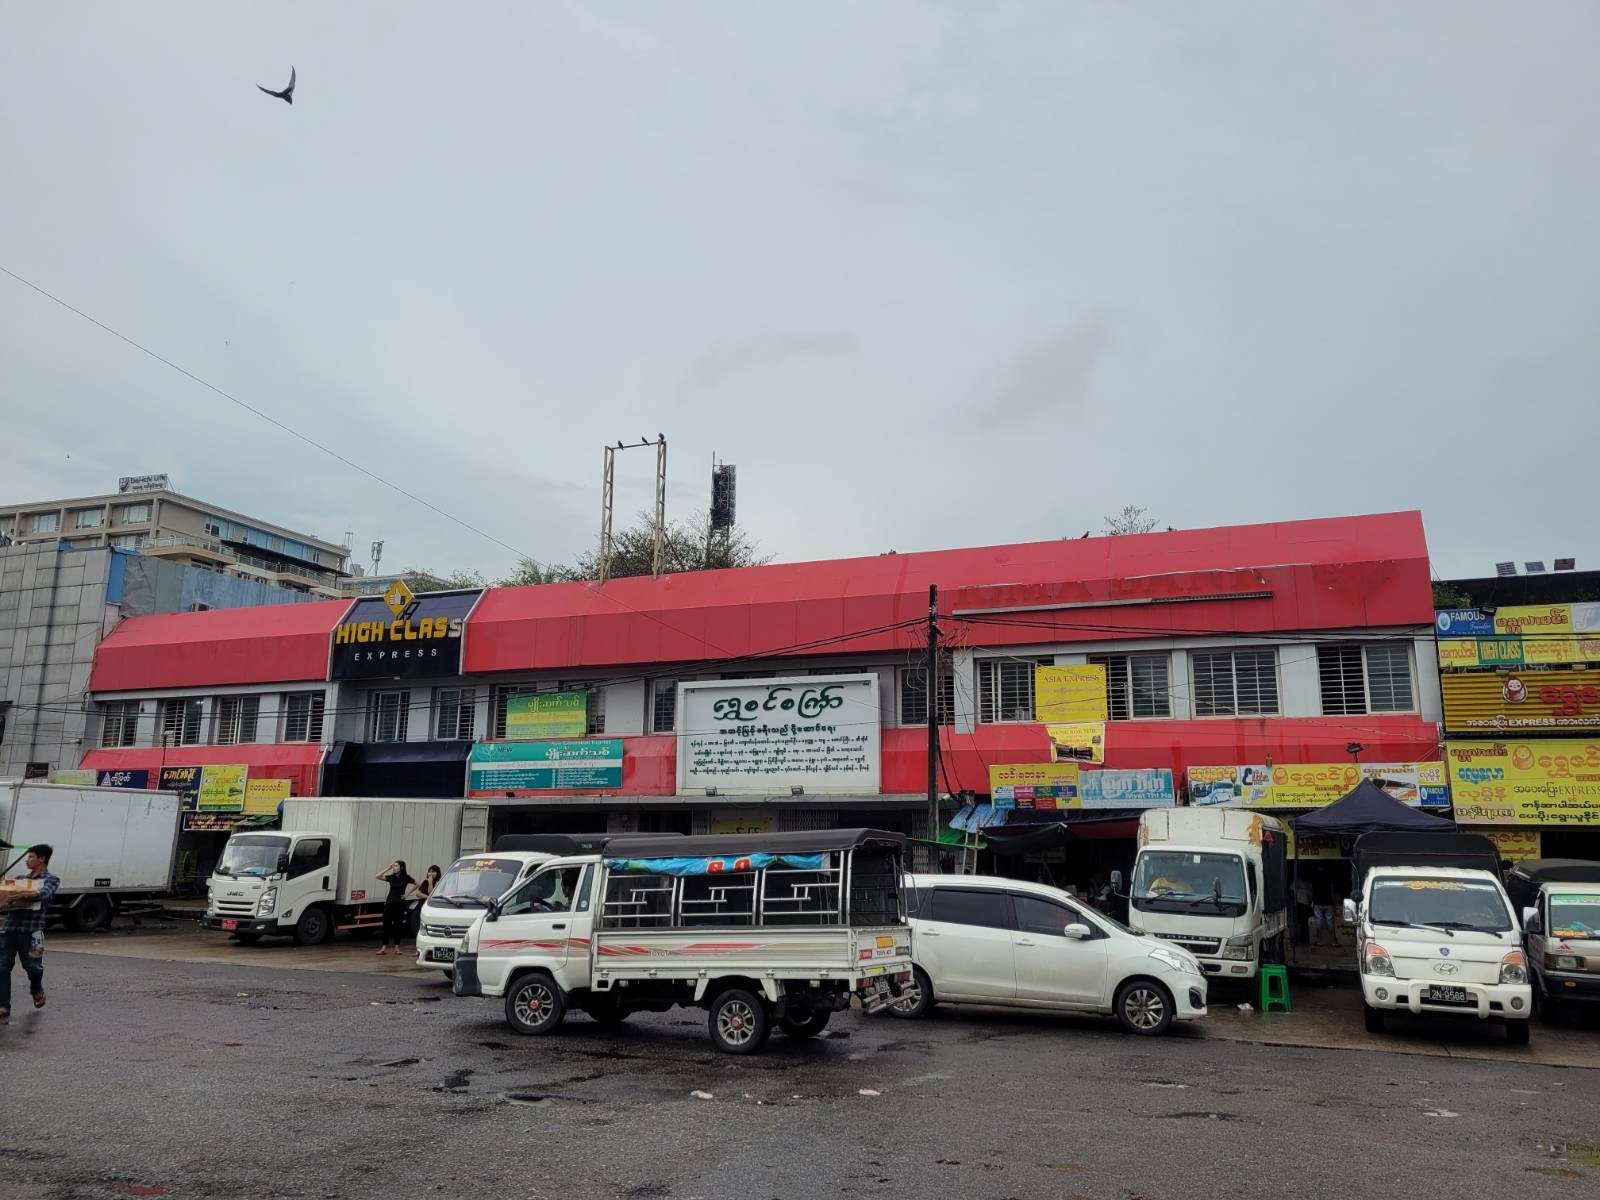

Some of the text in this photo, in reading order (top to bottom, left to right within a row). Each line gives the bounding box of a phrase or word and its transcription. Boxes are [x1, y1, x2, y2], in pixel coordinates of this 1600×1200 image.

[1450, 611, 1486, 622] FAMOUS
[335, 616, 462, 645] HIGH CLASS
[354, 648, 438, 661] EXPRESS
[1043, 674, 1099, 684] ASIA EXPRESS
[1509, 718, 1556, 727] EXPRESS
